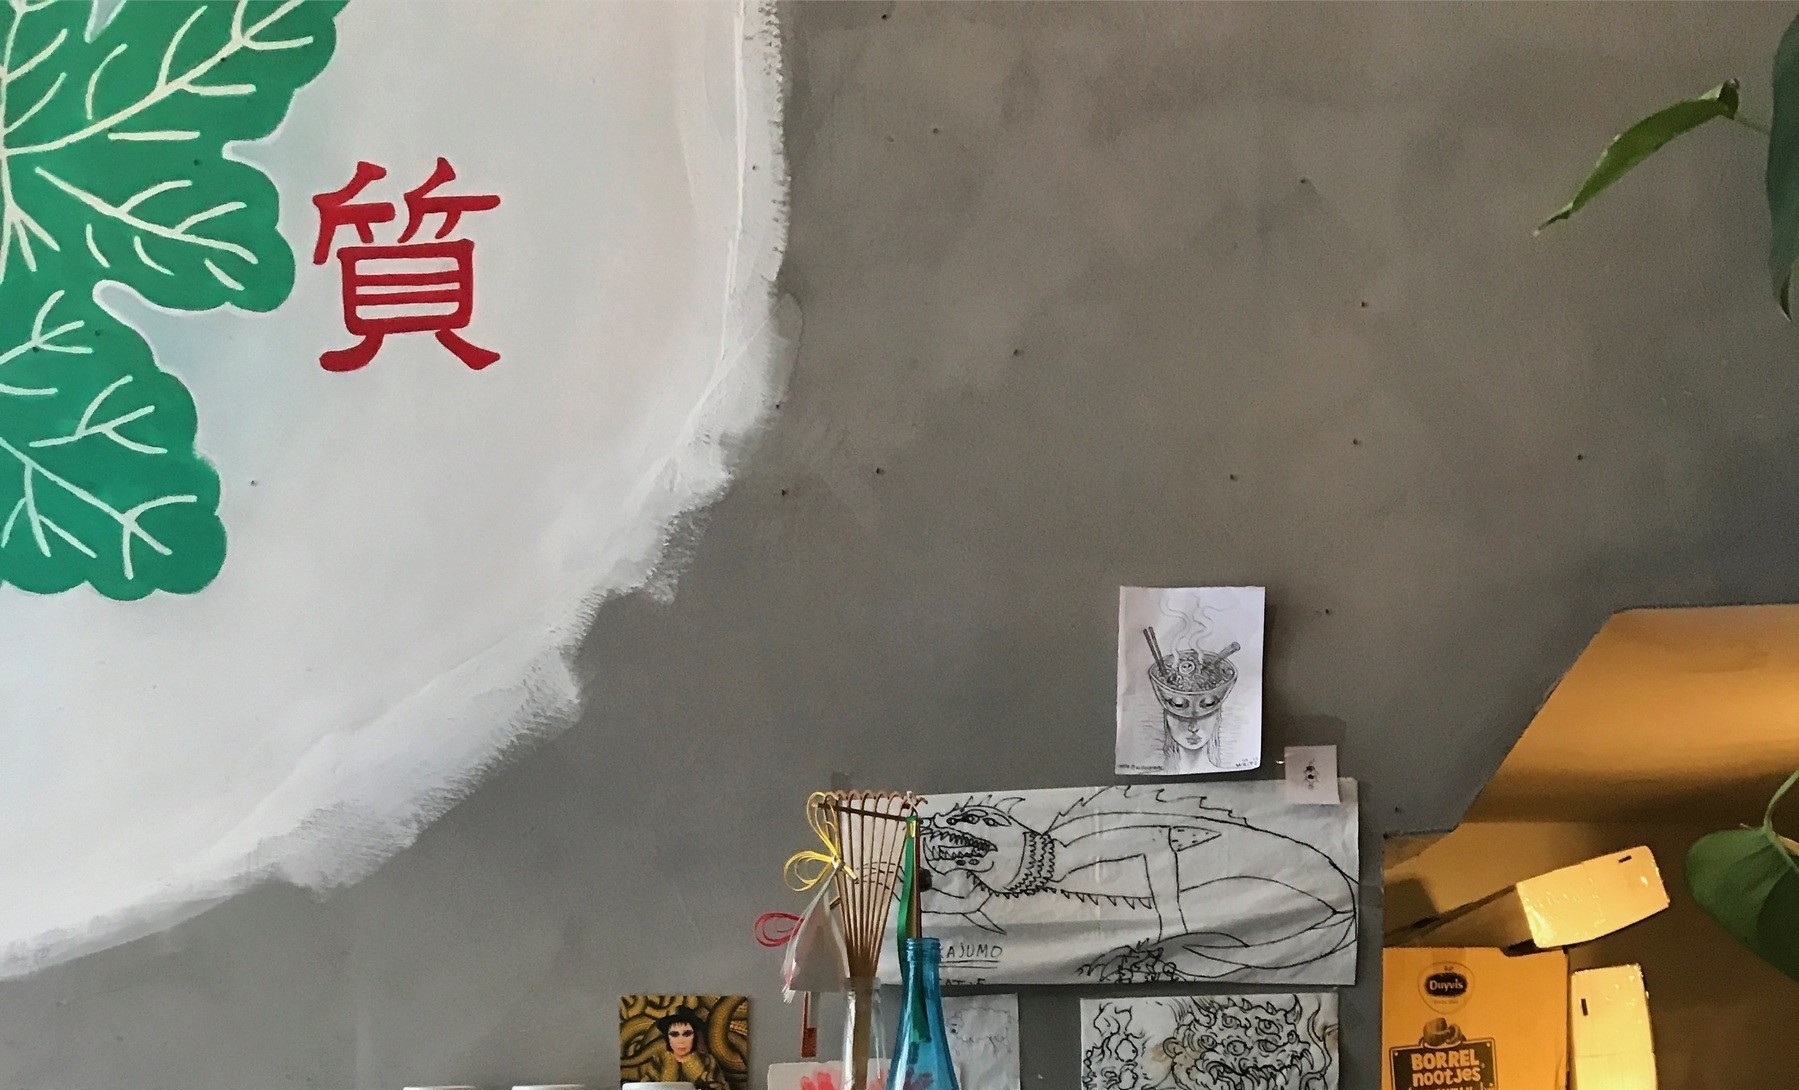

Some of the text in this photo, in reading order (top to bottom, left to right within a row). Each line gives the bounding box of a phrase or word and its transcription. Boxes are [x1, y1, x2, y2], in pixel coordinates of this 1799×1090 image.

[312, 157, 501, 372] 質
[940, 943, 1003, 958] AJUMO
[1429, 978, 1464, 992] Duyvis
[1411, 1049, 1480, 1071] BORREL
